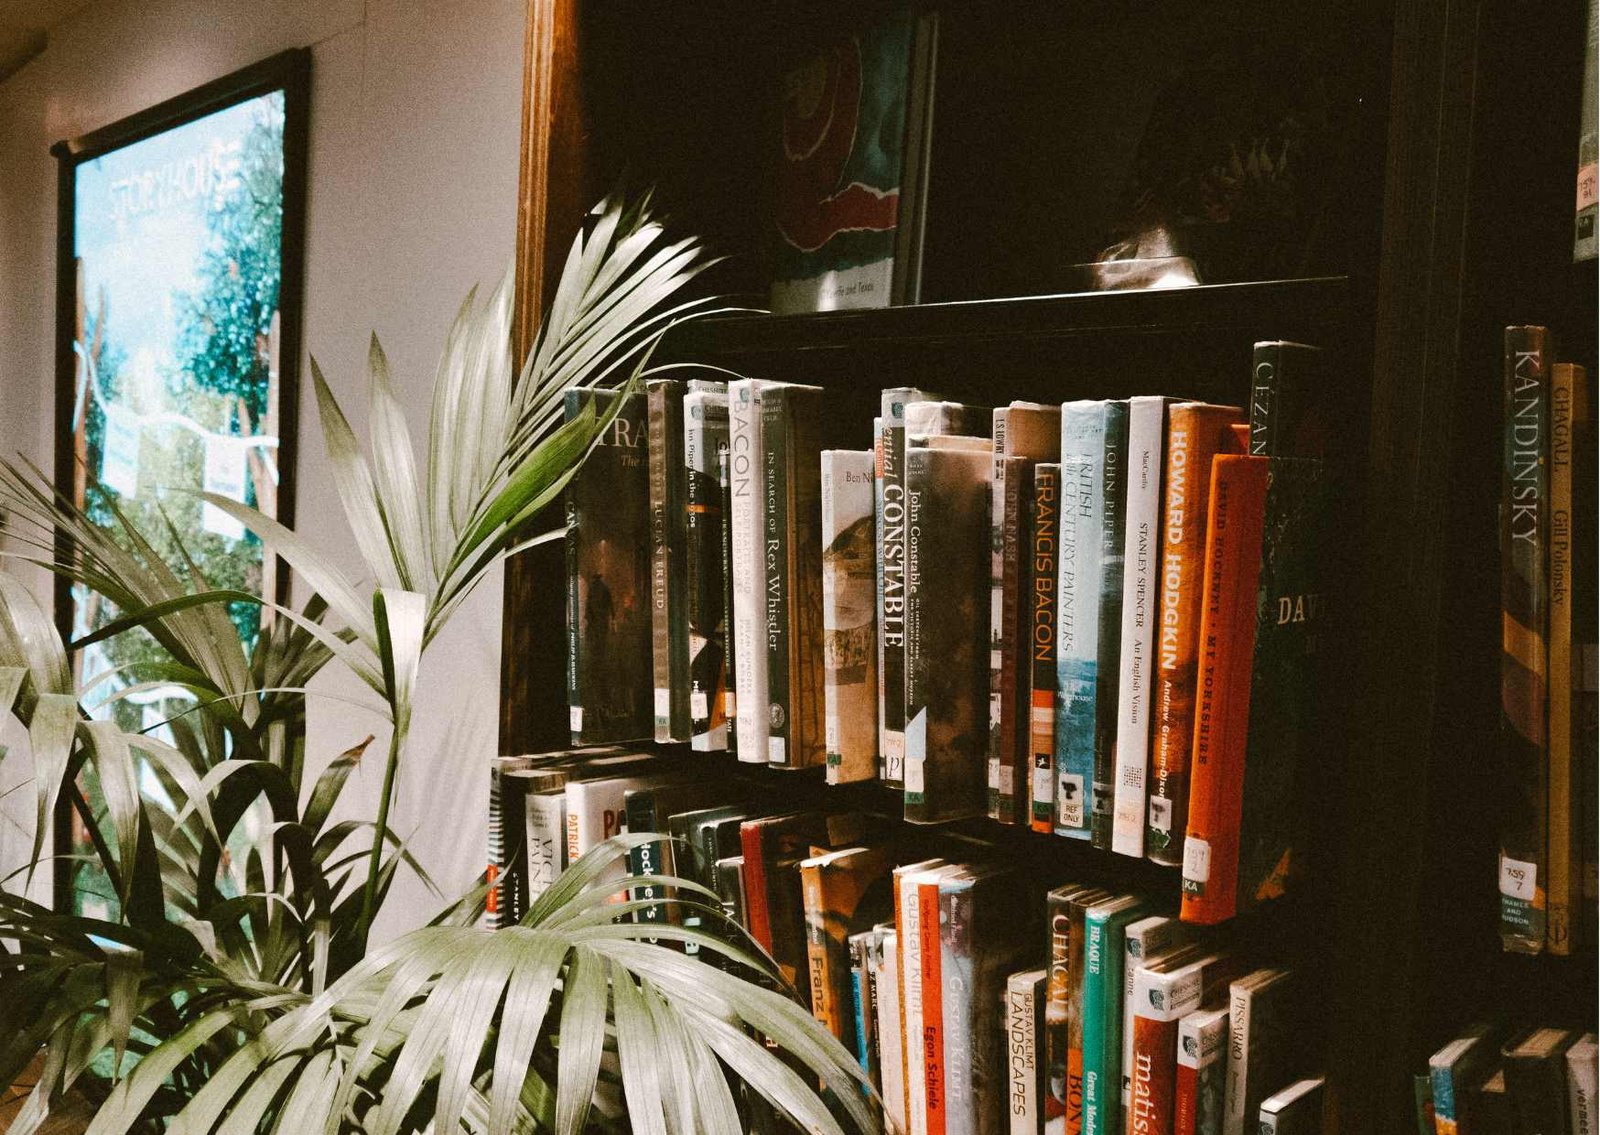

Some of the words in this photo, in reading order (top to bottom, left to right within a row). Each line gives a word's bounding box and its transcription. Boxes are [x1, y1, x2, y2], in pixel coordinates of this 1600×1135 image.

[734, 401, 750, 497] BACON
[1512, 350, 1540, 547] KANDINSKY
[1553, 386, 1570, 473] CHAGALL
[687, 444, 696, 469] Piper
[689, 470, 696, 480] in
[767, 451, 776, 465] IN
[845, 471, 861, 484] Ben
[1104, 443, 1118, 492] JOHN
[689, 482, 697, 498] the
[767, 468, 777, 513] SEARCH
[909, 490, 921, 523] John
[1167, 430, 1188, 545] HOWARD
[653, 501, 664, 555] LUCIAN
[767, 517, 778, 533] OF
[1035, 472, 1055, 572] FRANCIS
[1063, 481, 1077, 565] CENTURY
[1102, 501, 1115, 550] PIPER
[1555, 510, 1569, 541] Gill
[767, 538, 780, 570] Rex
[883, 484, 905, 647] CONSTABLE
[909, 526, 921, 594] Constable
[1137, 522, 1149, 573] STANLEY
[655, 561, 665, 609] FREUD
[1211, 535, 1226, 614] HOCKNEY
[1553, 541, 1569, 606] Polonsky
[767, 575, 781, 652] Whistler
[1034, 577, 1053, 661] BACON
[1062, 570, 1076, 652] PAINTERS
[1135, 577, 1147, 628] SPENCER
[1160, 554, 1184, 670] HODGKIN
[1133, 639, 1144, 653] An
[1207, 635, 1218, 660] MY
[1131, 656, 1142, 691] English
[1131, 694, 1141, 725] Vision
[1161, 680, 1173, 721] Andrew
[1199, 666, 1216, 766] YORKSHIRE
[1063, 813, 1080, 824] ONLY
[1065, 804, 1079, 813] REF
[569, 813, 580, 859] PATRICK
[512, 871, 520, 921] STANLEY
[1184, 880, 1199, 892] KA
[1088, 925, 1101, 975] BRAQUE
[811, 957, 826, 1012] Franz
[869, 983, 878, 1011] MARC
[1023, 992, 1033, 1037] GUSTAV
[1232, 996, 1247, 1060] PISSARRO
[925, 1026, 938, 1058] Egon
[1010, 990, 1027, 1118] LANDSCAPES
[1025, 1038, 1034, 1071] KLIMT
[927, 1062, 939, 1110] Schiele
[1086, 1070, 1098, 1100] Great
[1179, 1092, 1188, 1130] THOMSON
